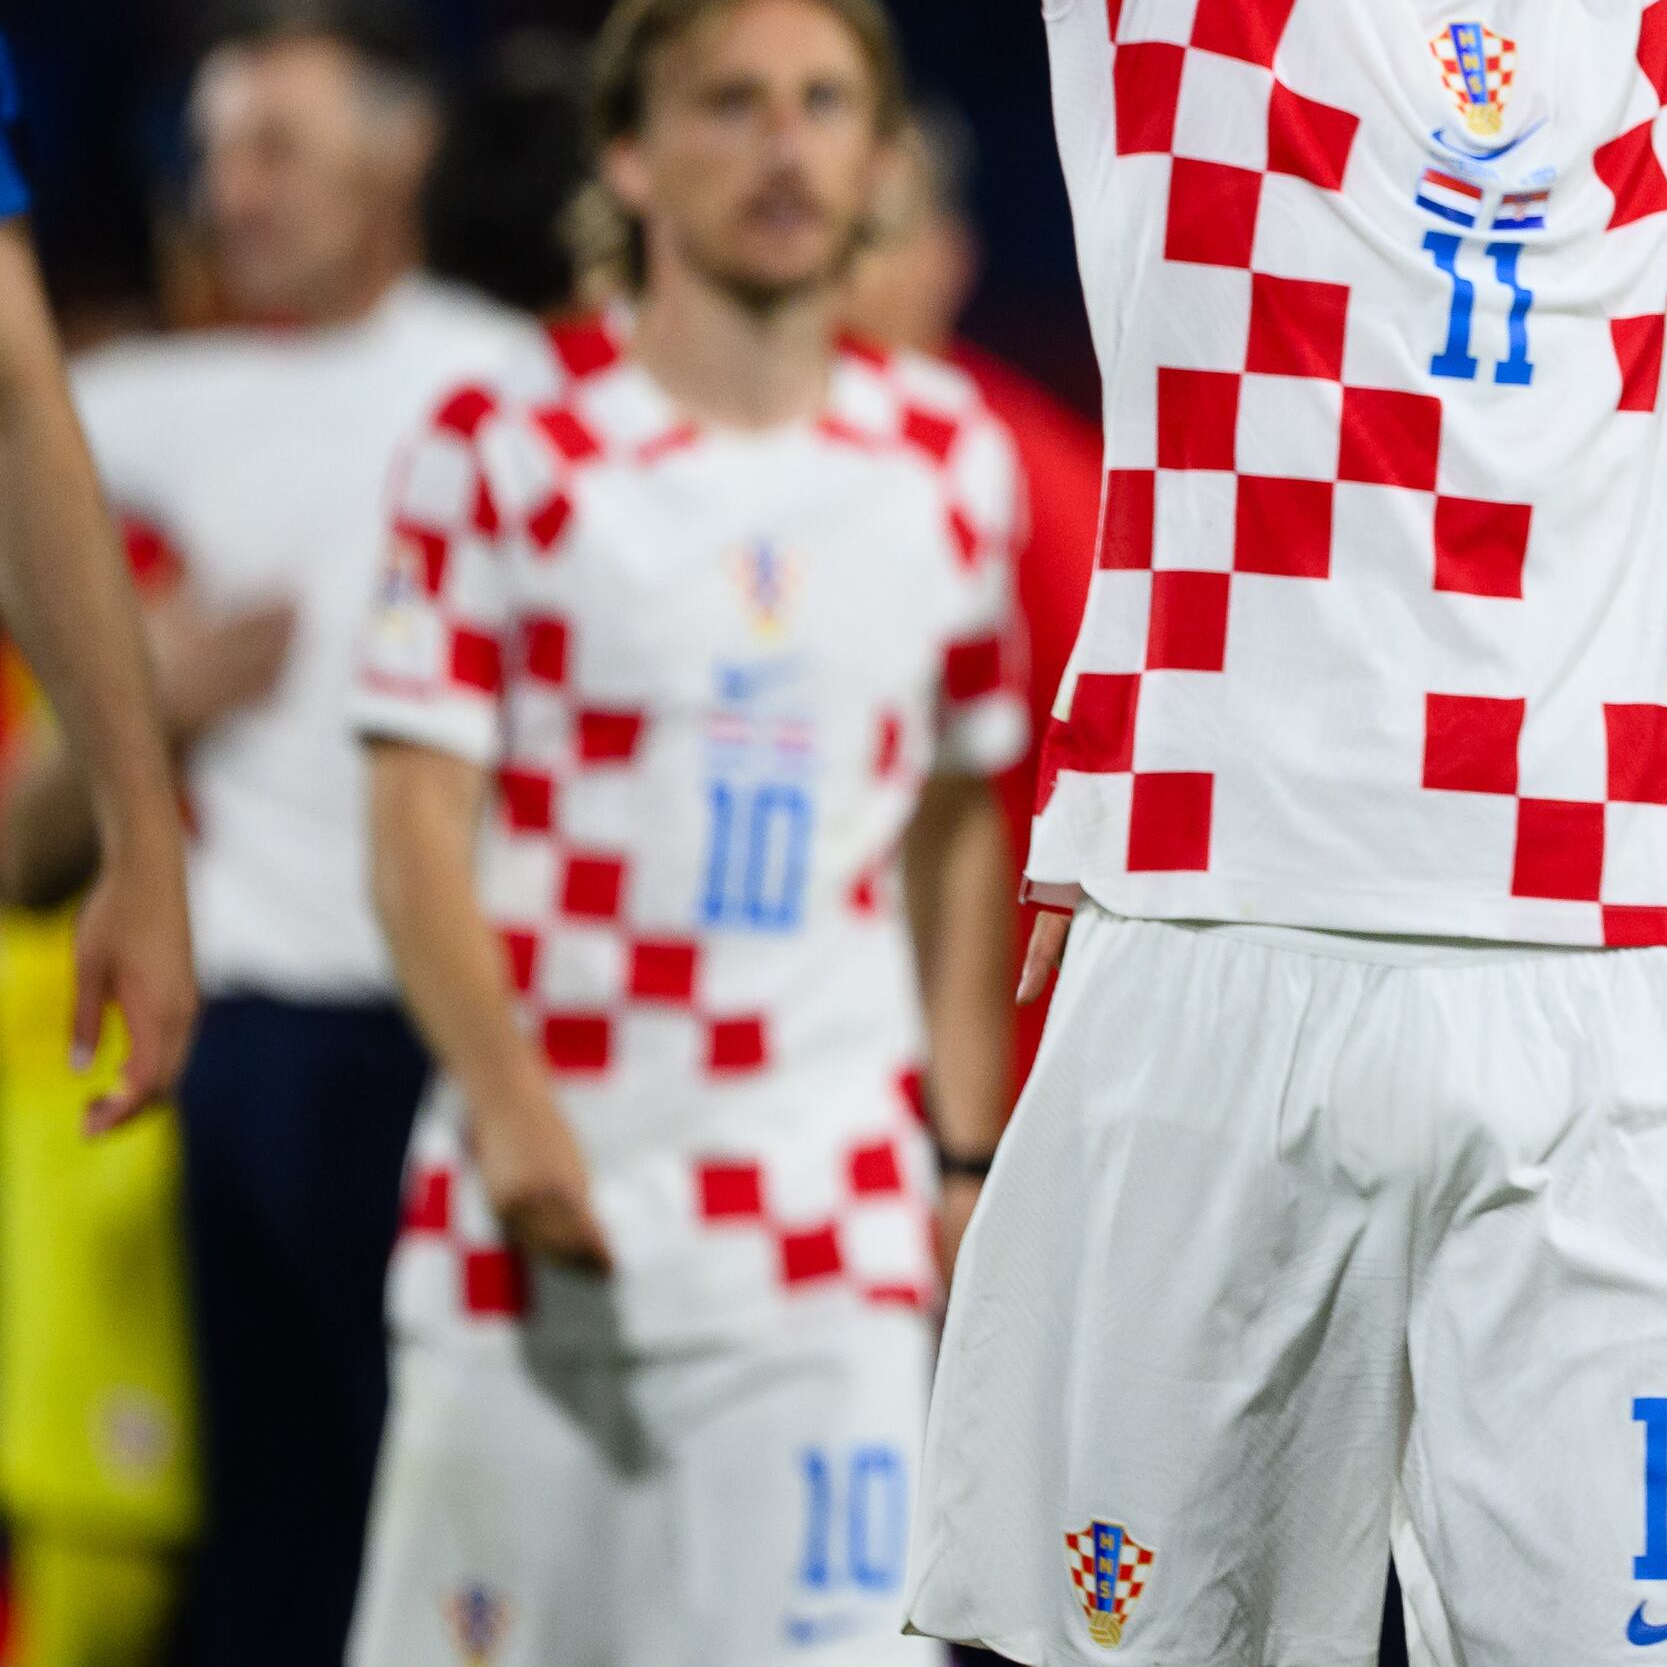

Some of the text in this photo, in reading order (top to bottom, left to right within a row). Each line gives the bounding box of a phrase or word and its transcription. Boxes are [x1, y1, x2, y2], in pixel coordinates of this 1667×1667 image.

[1422, 230, 1543, 386] 11
[699, 779, 811, 934] 10
[797, 1445, 905, 1593] 10
[1099, 1533, 1114, 1599] HNS
